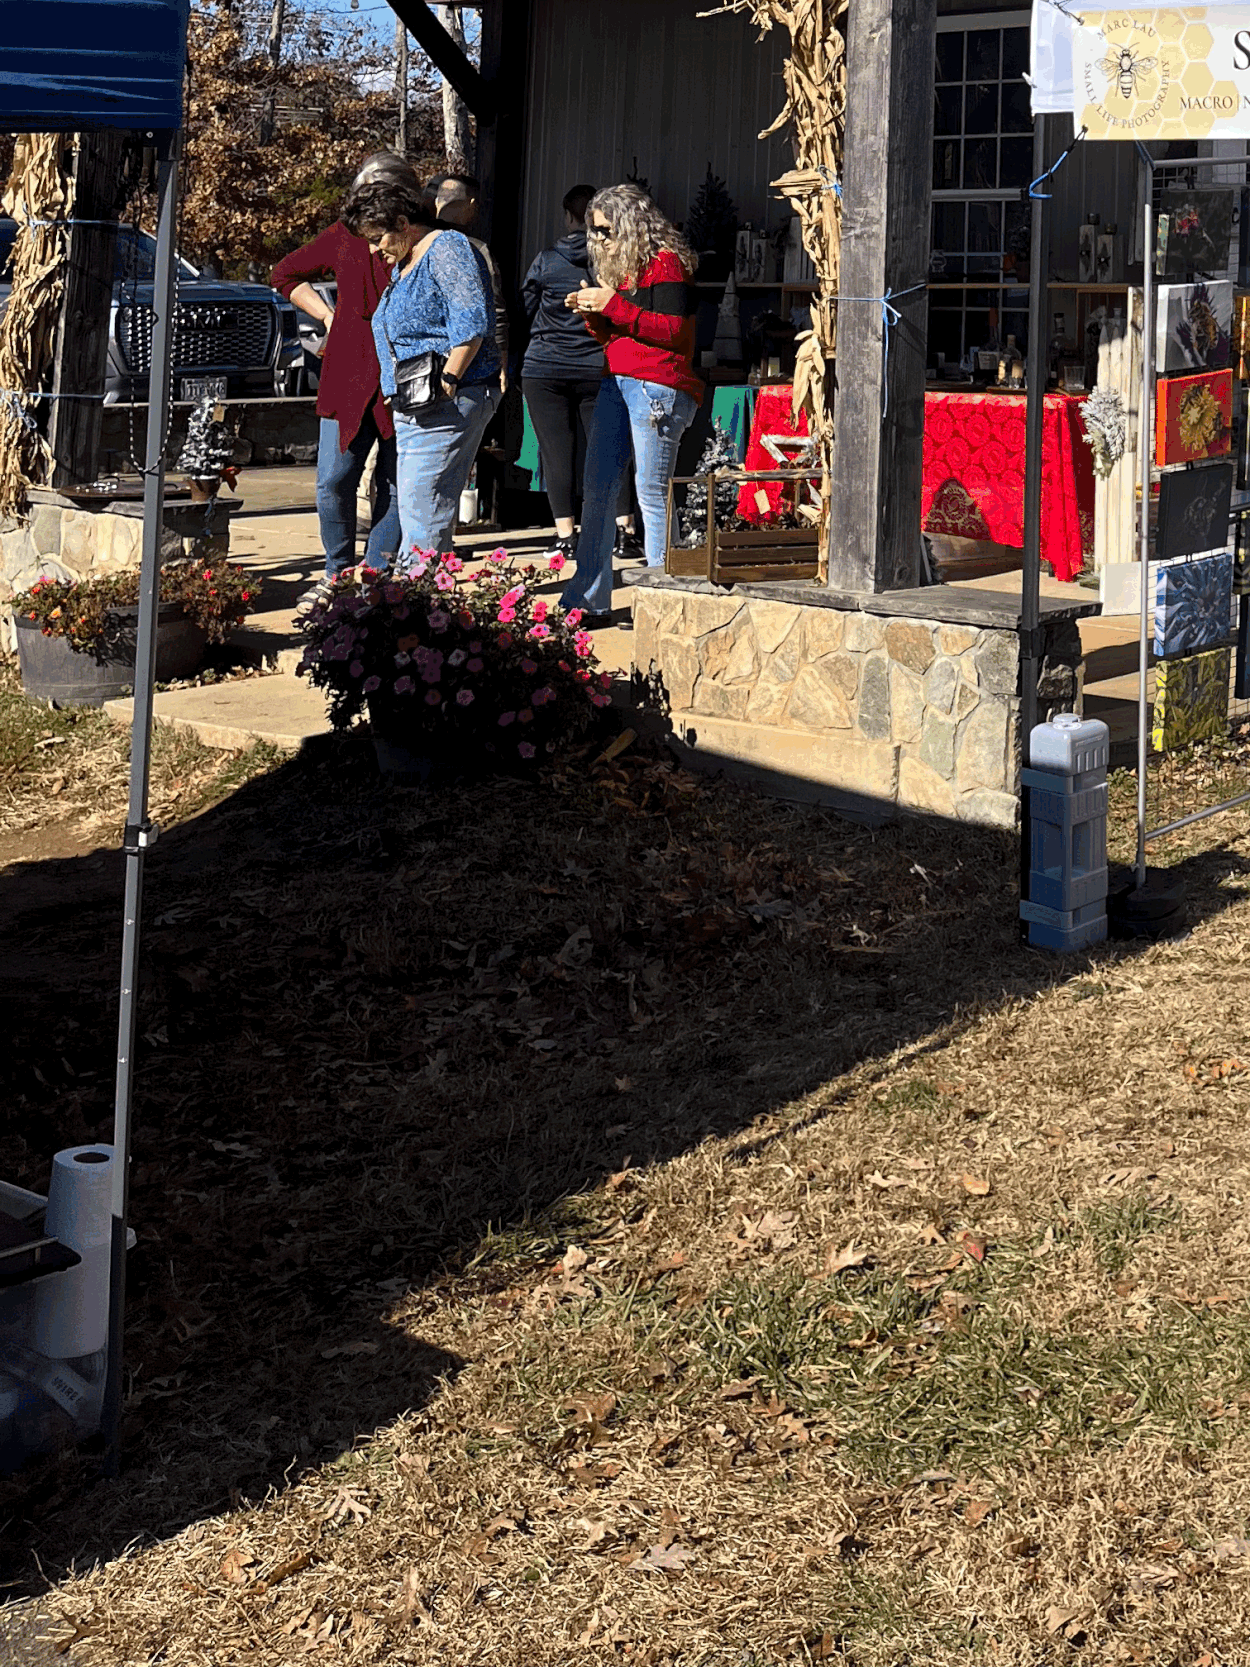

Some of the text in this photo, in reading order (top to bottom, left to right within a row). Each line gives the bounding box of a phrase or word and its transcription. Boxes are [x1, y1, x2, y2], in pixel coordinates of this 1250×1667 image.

[1097, 18, 1157, 40] MARC LAU
[1084, 59, 1170, 129] SMALL LIFE PHOTOGRAPHY
[1180, 95, 1234, 110] MACRO
